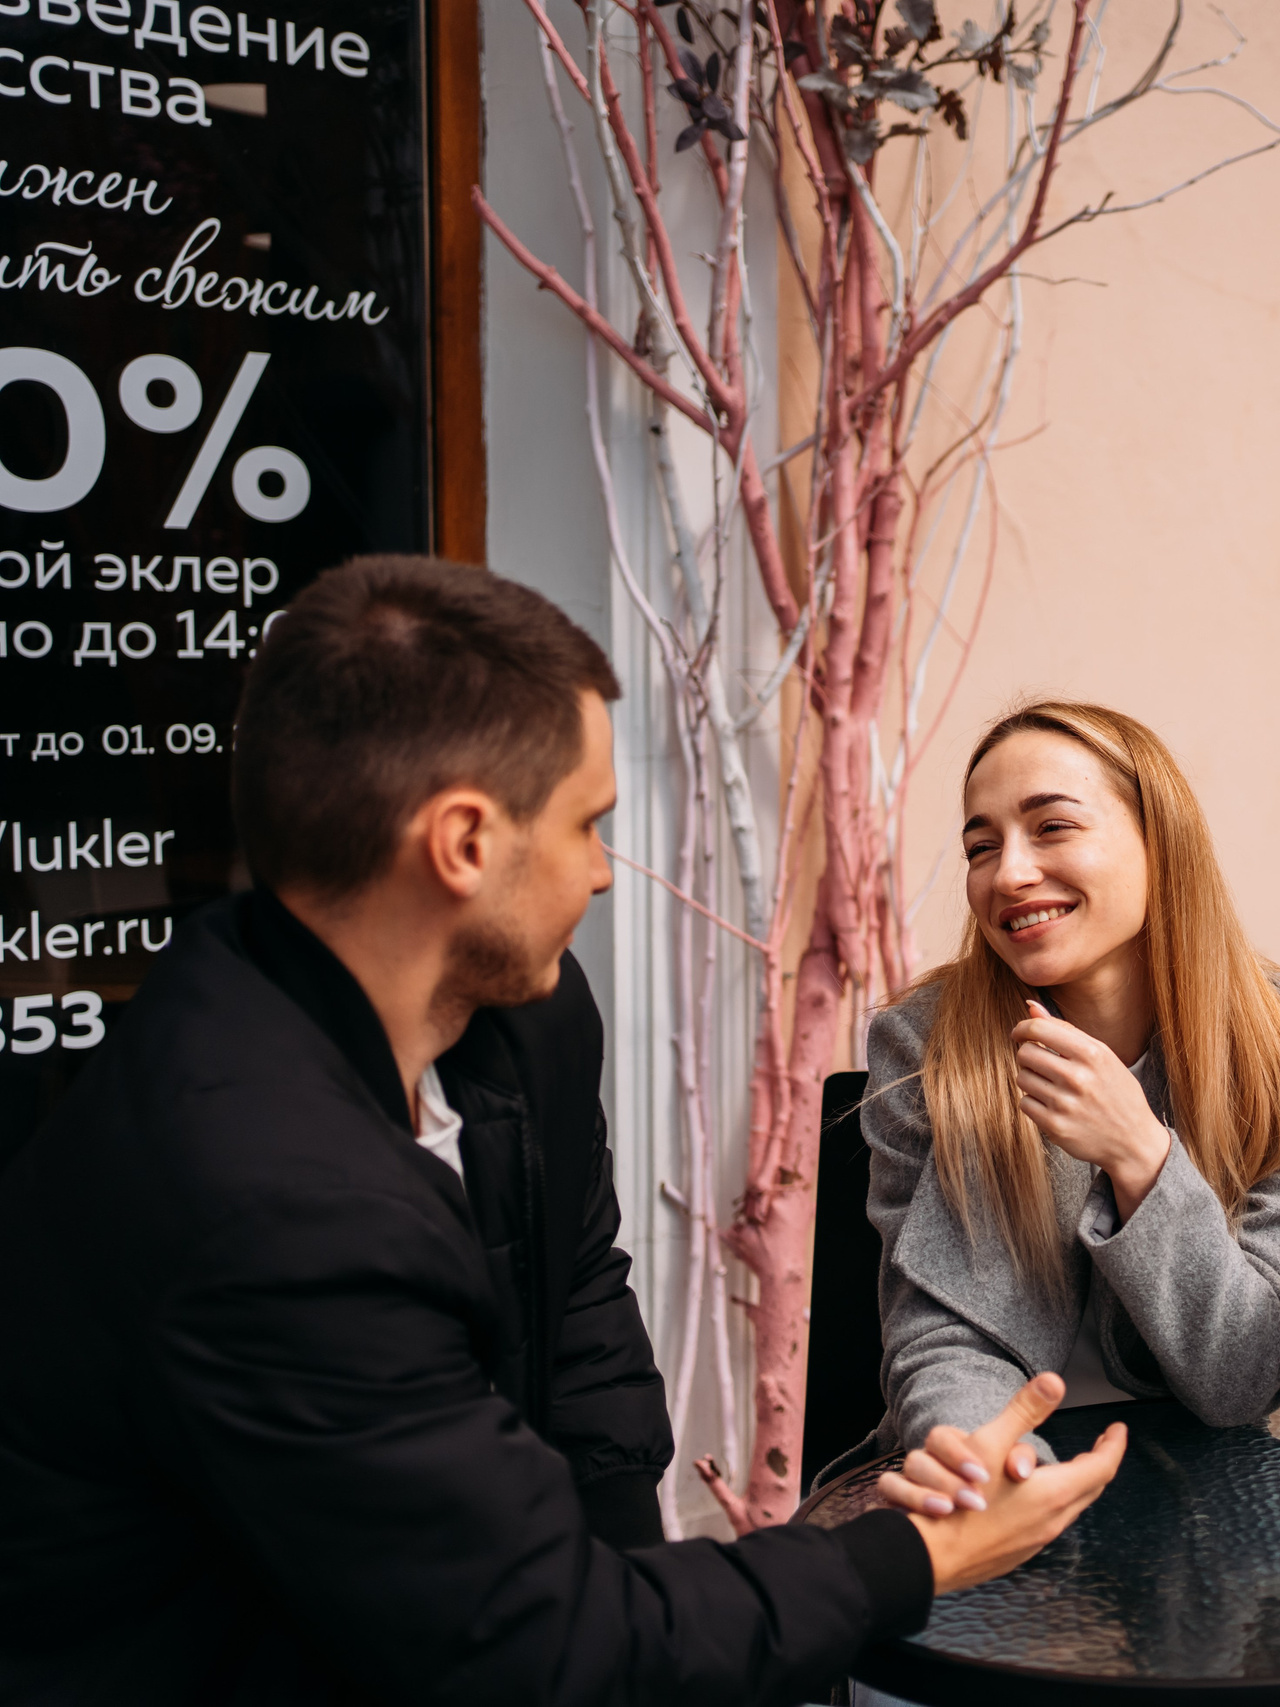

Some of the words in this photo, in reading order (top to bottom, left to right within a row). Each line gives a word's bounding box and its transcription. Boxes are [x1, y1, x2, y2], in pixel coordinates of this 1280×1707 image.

[135, 218, 389, 325] свежим
[0, 346, 311, 530] 0%
[0, 540, 72, 589] ой
[94, 553, 279, 608] эклер
[0, 621, 53, 658] о
[74, 622, 157, 667] до
[32, 732, 84, 762] до
[102, 724, 155, 755] 01.
[166, 723, 223, 754] 09.
[0, 910, 173, 963] kler.ru
[0, 990, 106, 1055] 53
